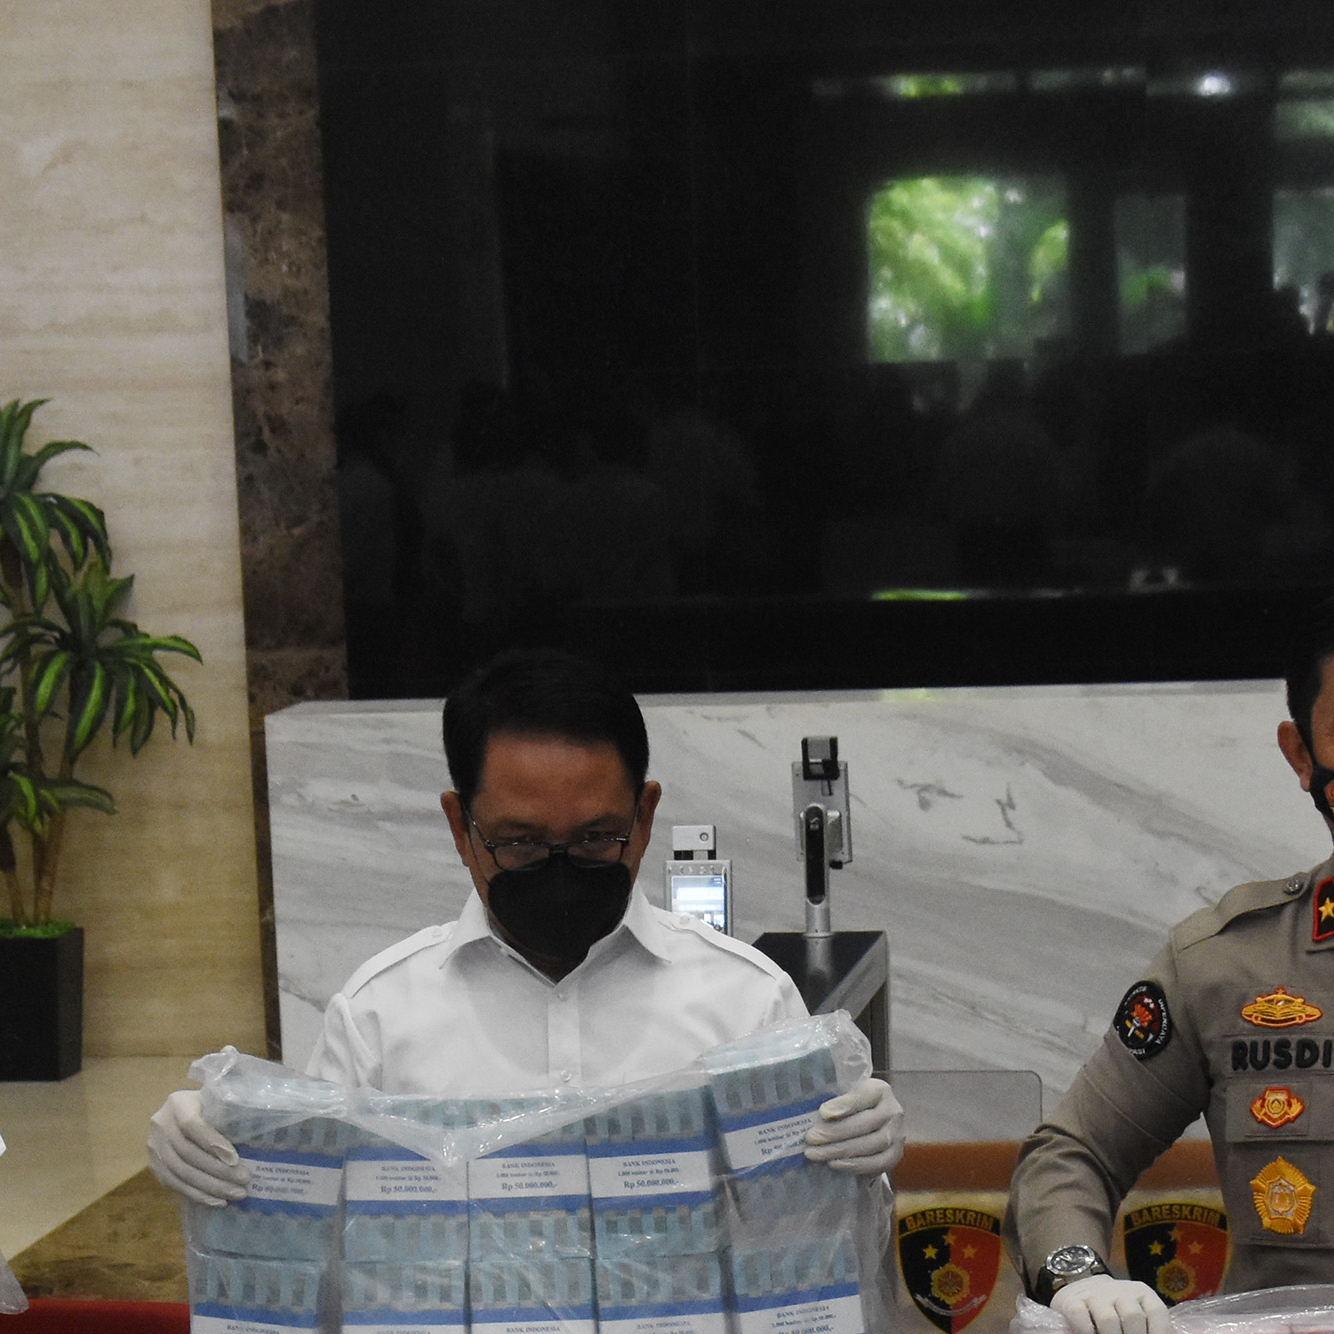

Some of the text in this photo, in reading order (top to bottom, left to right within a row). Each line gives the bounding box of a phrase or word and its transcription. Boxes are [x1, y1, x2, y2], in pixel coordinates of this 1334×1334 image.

[1232, 1038, 1333, 1071] RUSDI
[502, 1183, 512, 1191] Rp
[624, 1181, 635, 1189] Rp
[906, 1209, 994, 1231] BARESKRIM
[1132, 1204, 1221, 1227] BARESKRIM
